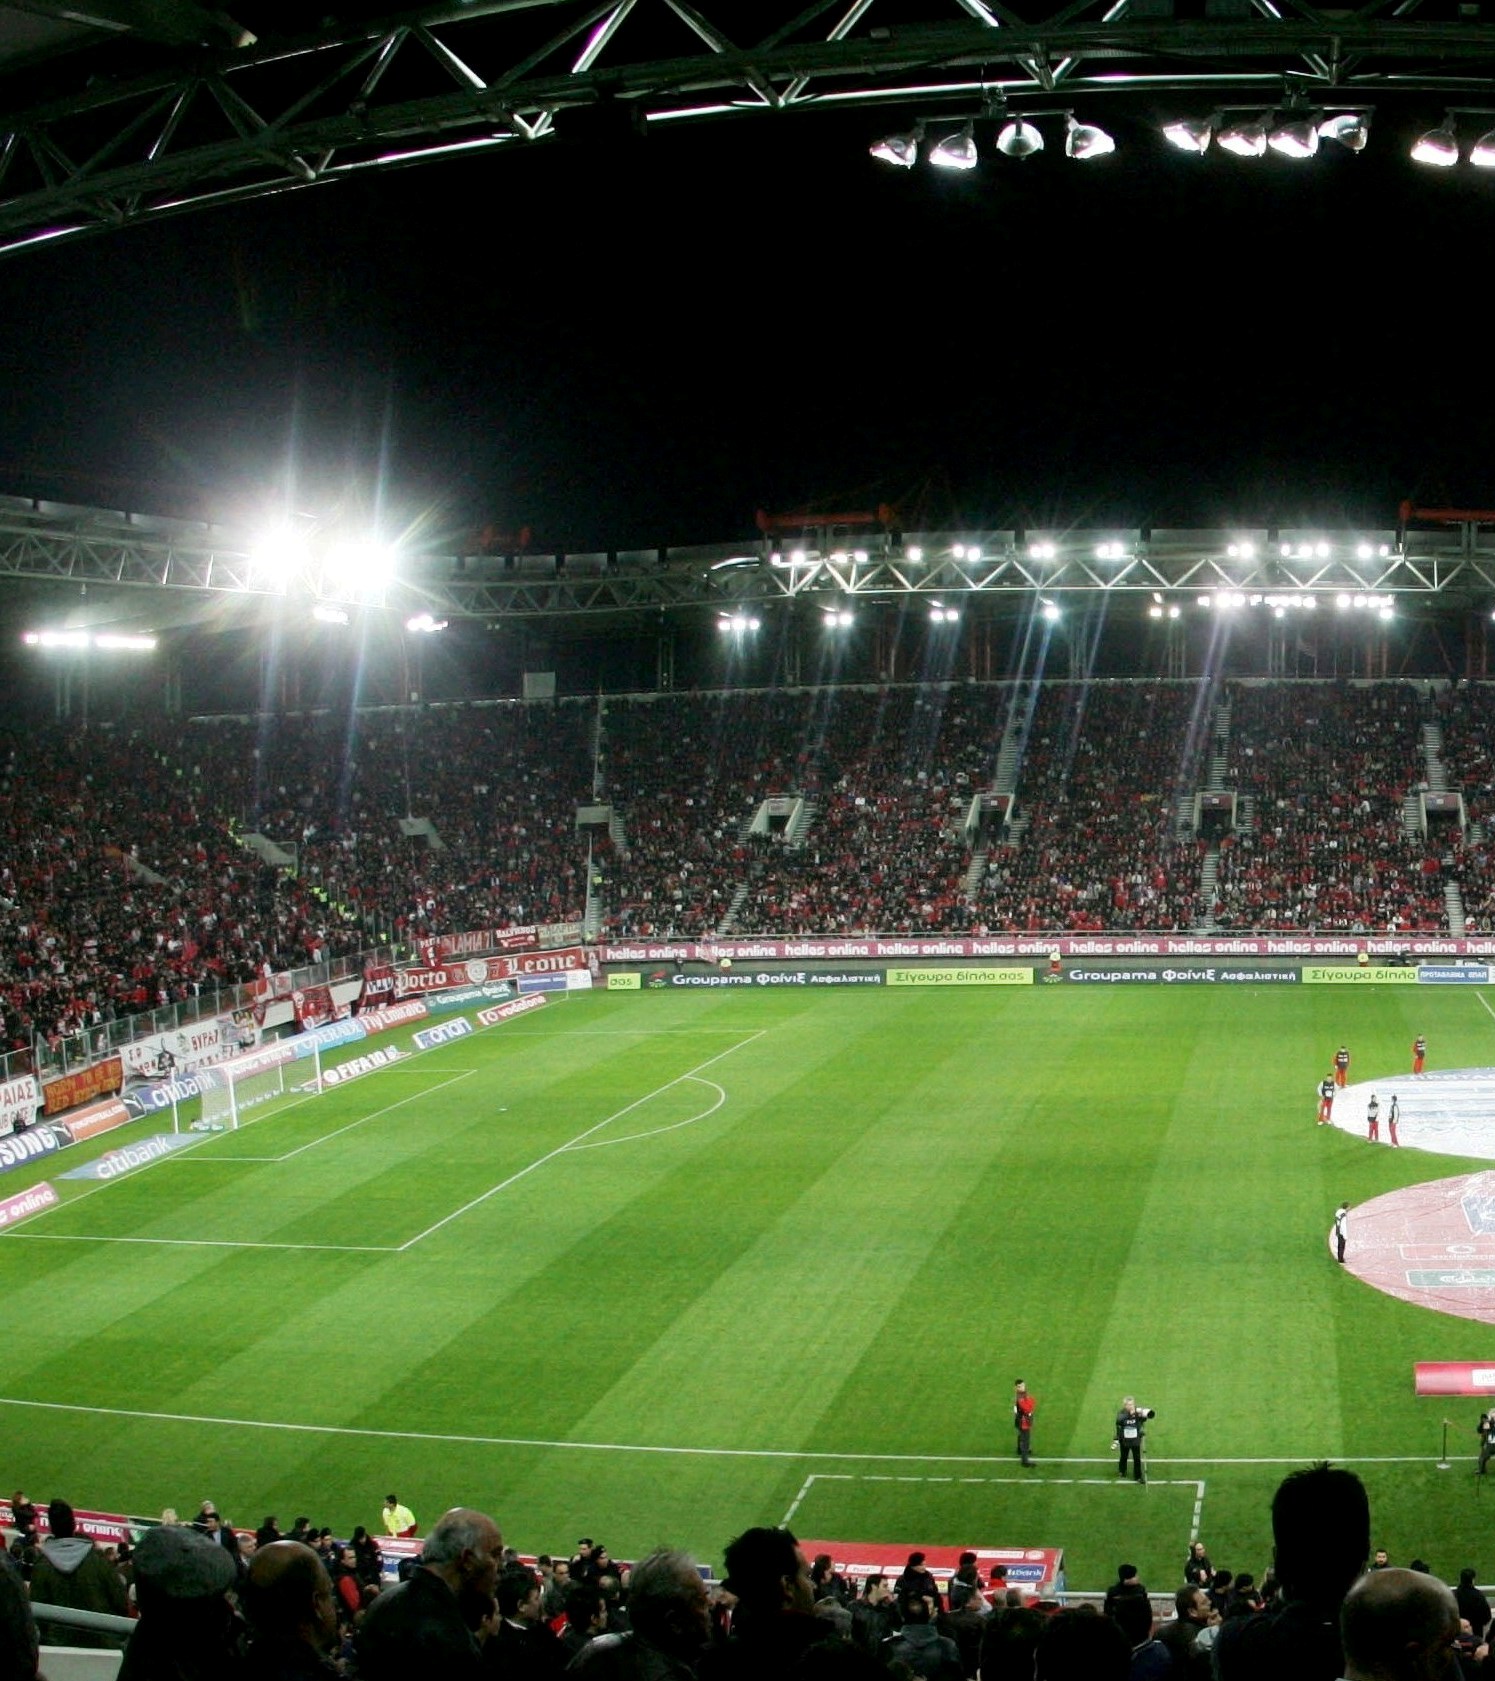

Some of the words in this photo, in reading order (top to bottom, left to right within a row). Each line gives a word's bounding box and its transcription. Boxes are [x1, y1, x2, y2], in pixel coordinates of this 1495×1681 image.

[738, 946, 776, 956] online
[785, 944, 825, 956] hellas
[829, 944, 868, 955] online
[878, 943, 918, 955] hellas
[923, 942, 963, 954] online
[973, 942, 1014, 954] hellas
[1018, 942, 1060, 953] online
[1070, 942, 1112, 953] hellas
[1116, 942, 1158, 953] online
[1169, 941, 1211, 953] hellas
[1215, 941, 1258, 953] online
[1268, 941, 1311, 952] hellas
[1314, 941, 1357, 952] online
[1368, 941, 1410, 952] hellas
[1414, 941, 1457, 952] online
[607, 949, 646, 959] hellas
[650, 948, 687, 958] online
[502, 954, 576, 976] Leone
[673, 974, 752, 986] Groupama
[757, 972, 806, 985] Φοίνιξ
[896, 971, 952, 982] Σίγουρα
[1070, 969, 1157, 982] Groupama
[1162, 968, 1216, 982] Φοίνιξ
[1312, 969, 1372, 981] Σίγουρα
[500, 995, 546, 1018] vodafone
[383, 1002, 427, 1024] Emirates
[0, 1127, 56, 1168] SUNG
[96, 1136, 173, 1179] citibank
